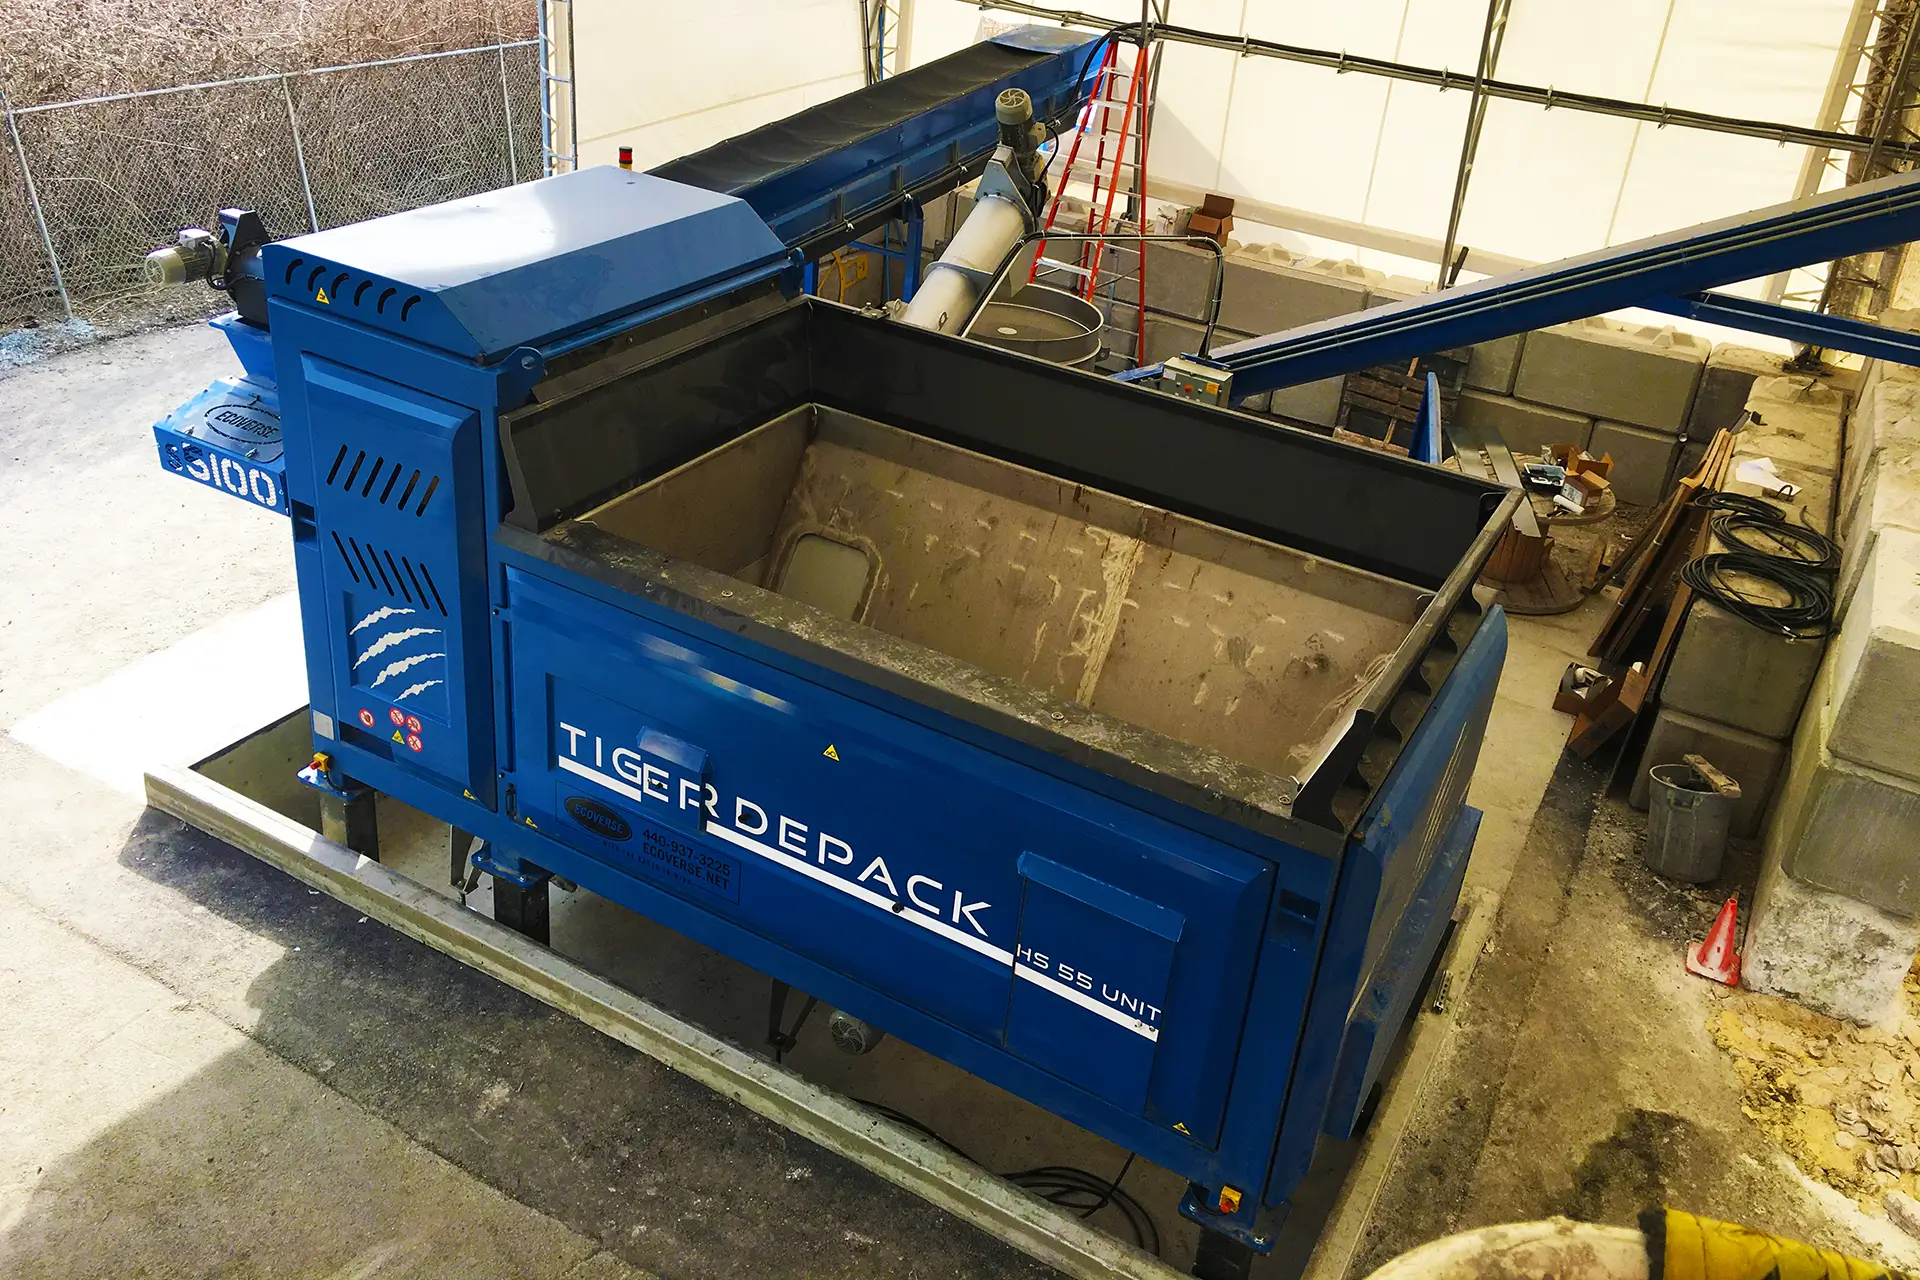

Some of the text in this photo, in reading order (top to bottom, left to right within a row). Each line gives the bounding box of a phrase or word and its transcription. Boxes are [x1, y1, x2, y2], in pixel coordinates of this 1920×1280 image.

[214, 410, 279, 439] ECOVERSE
[574, 803, 624, 834] ECOVERSE
[642, 828, 731, 877] 440-937-3225
[643, 841, 729, 890] ECOVERSE.NET
[1016, 943, 1162, 1021] HS 55 UNIT
